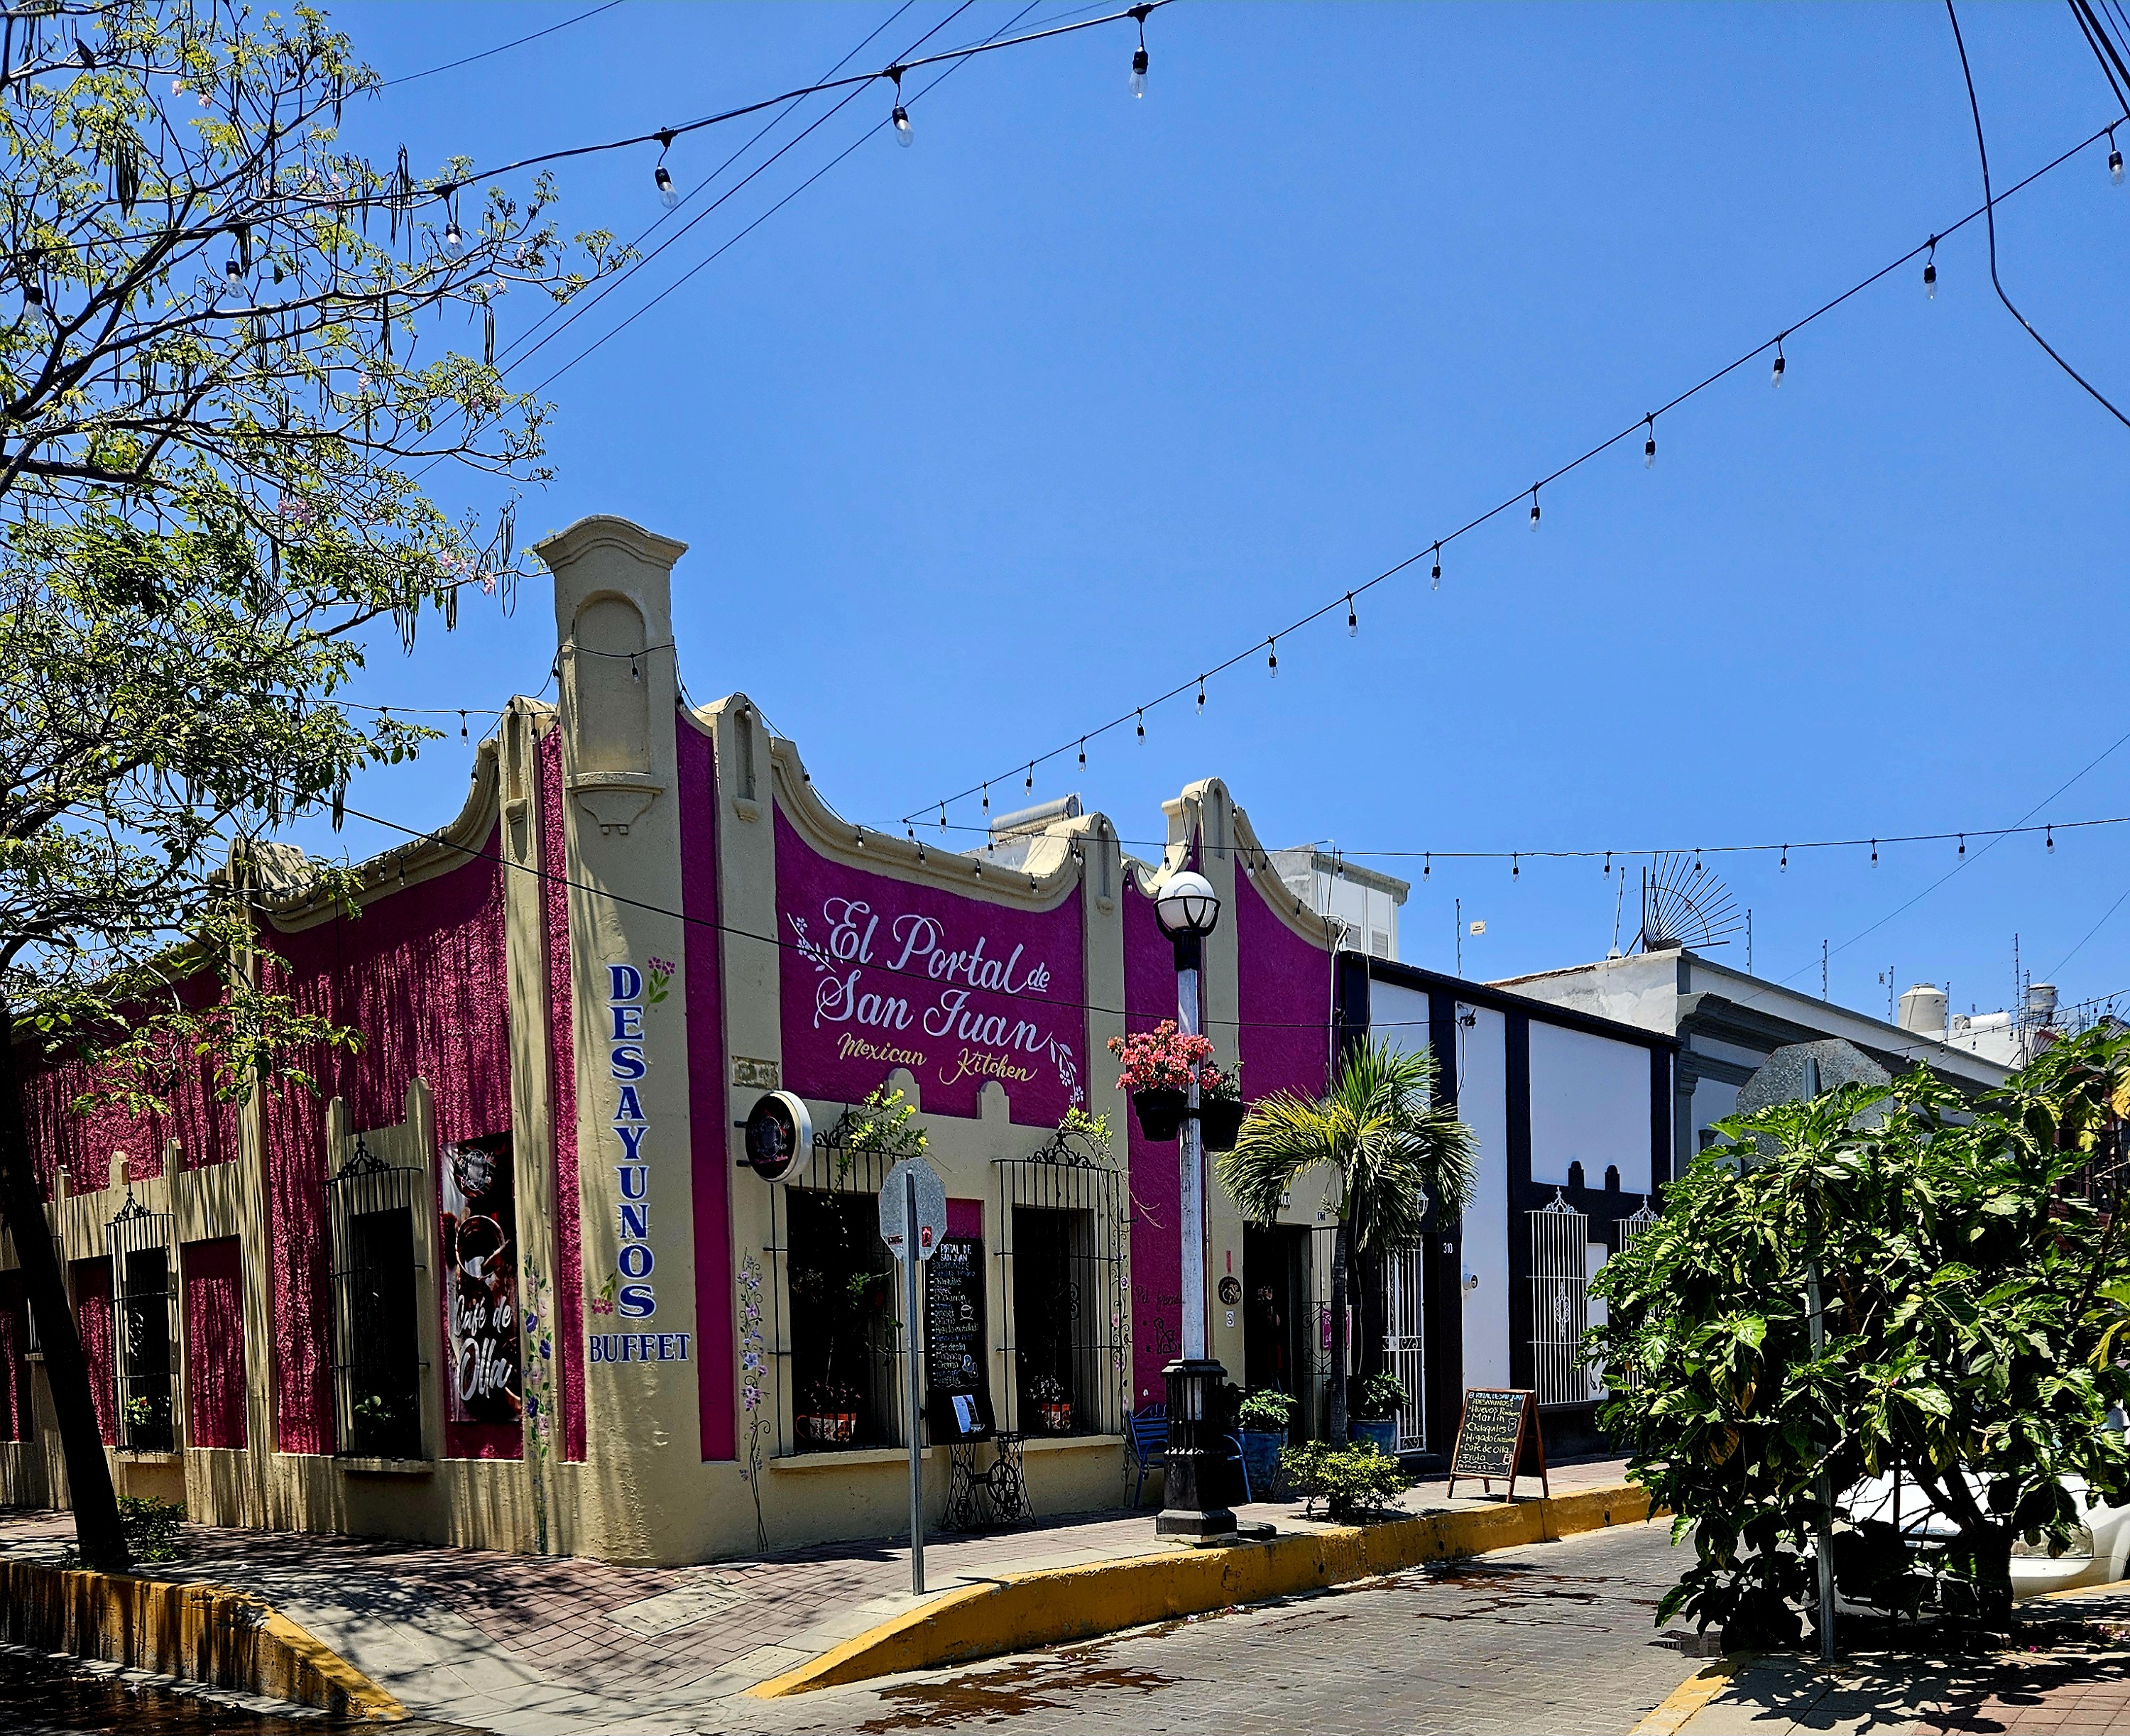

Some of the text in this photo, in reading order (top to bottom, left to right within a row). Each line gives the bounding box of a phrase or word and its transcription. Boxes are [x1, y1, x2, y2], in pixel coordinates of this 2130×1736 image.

[824, 897, 1051, 994] El Portal de
[814, 969, 1053, 1053] San Juan
[837, 1032, 1038, 1086] Mexican Kitchen
[606, 964, 657, 1319] DESAYUNOS
[454, 1294, 512, 1336] Café de
[457, 1337, 513, 1402] Olla
[589, 1333, 691, 1363] BUFFET
